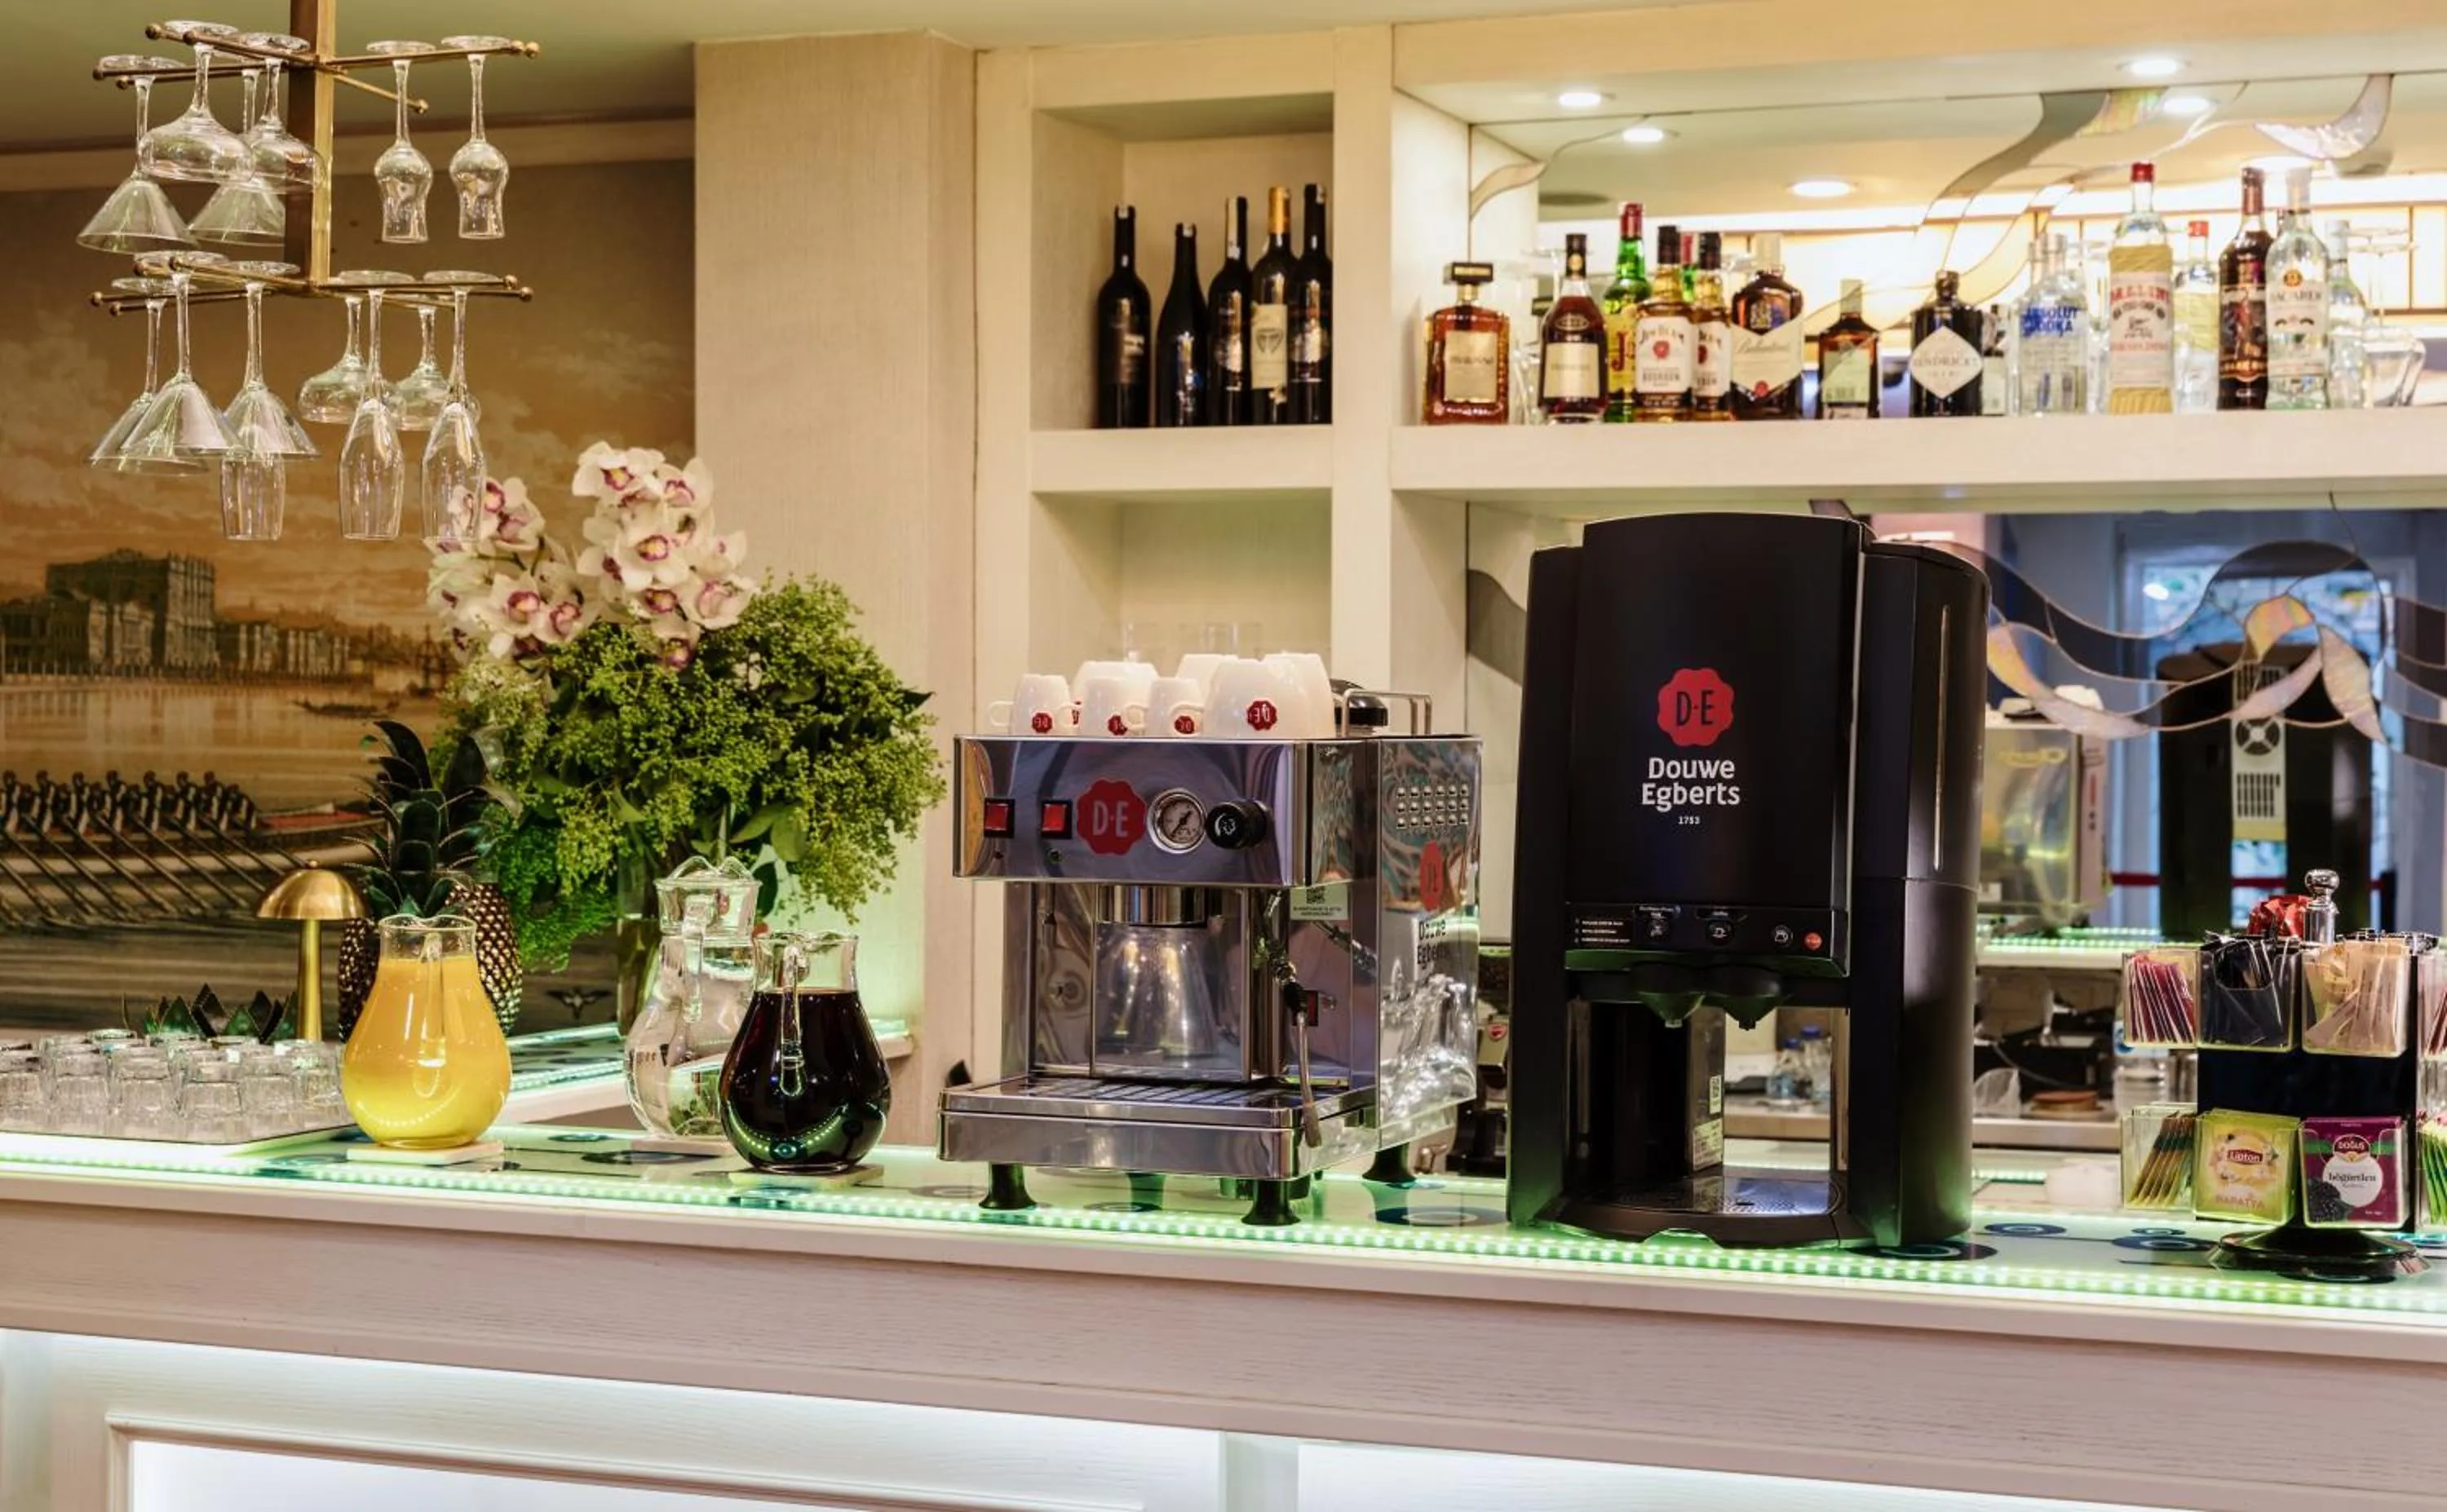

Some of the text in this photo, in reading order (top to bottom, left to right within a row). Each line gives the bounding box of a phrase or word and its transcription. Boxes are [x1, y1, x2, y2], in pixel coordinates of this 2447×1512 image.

[1648, 757, 1735, 779] Douwe
[1642, 782, 1740, 812] Egberts
[1678, 816, 1701, 825] 1753
[2230, 1151, 2260, 1162] Lipton
